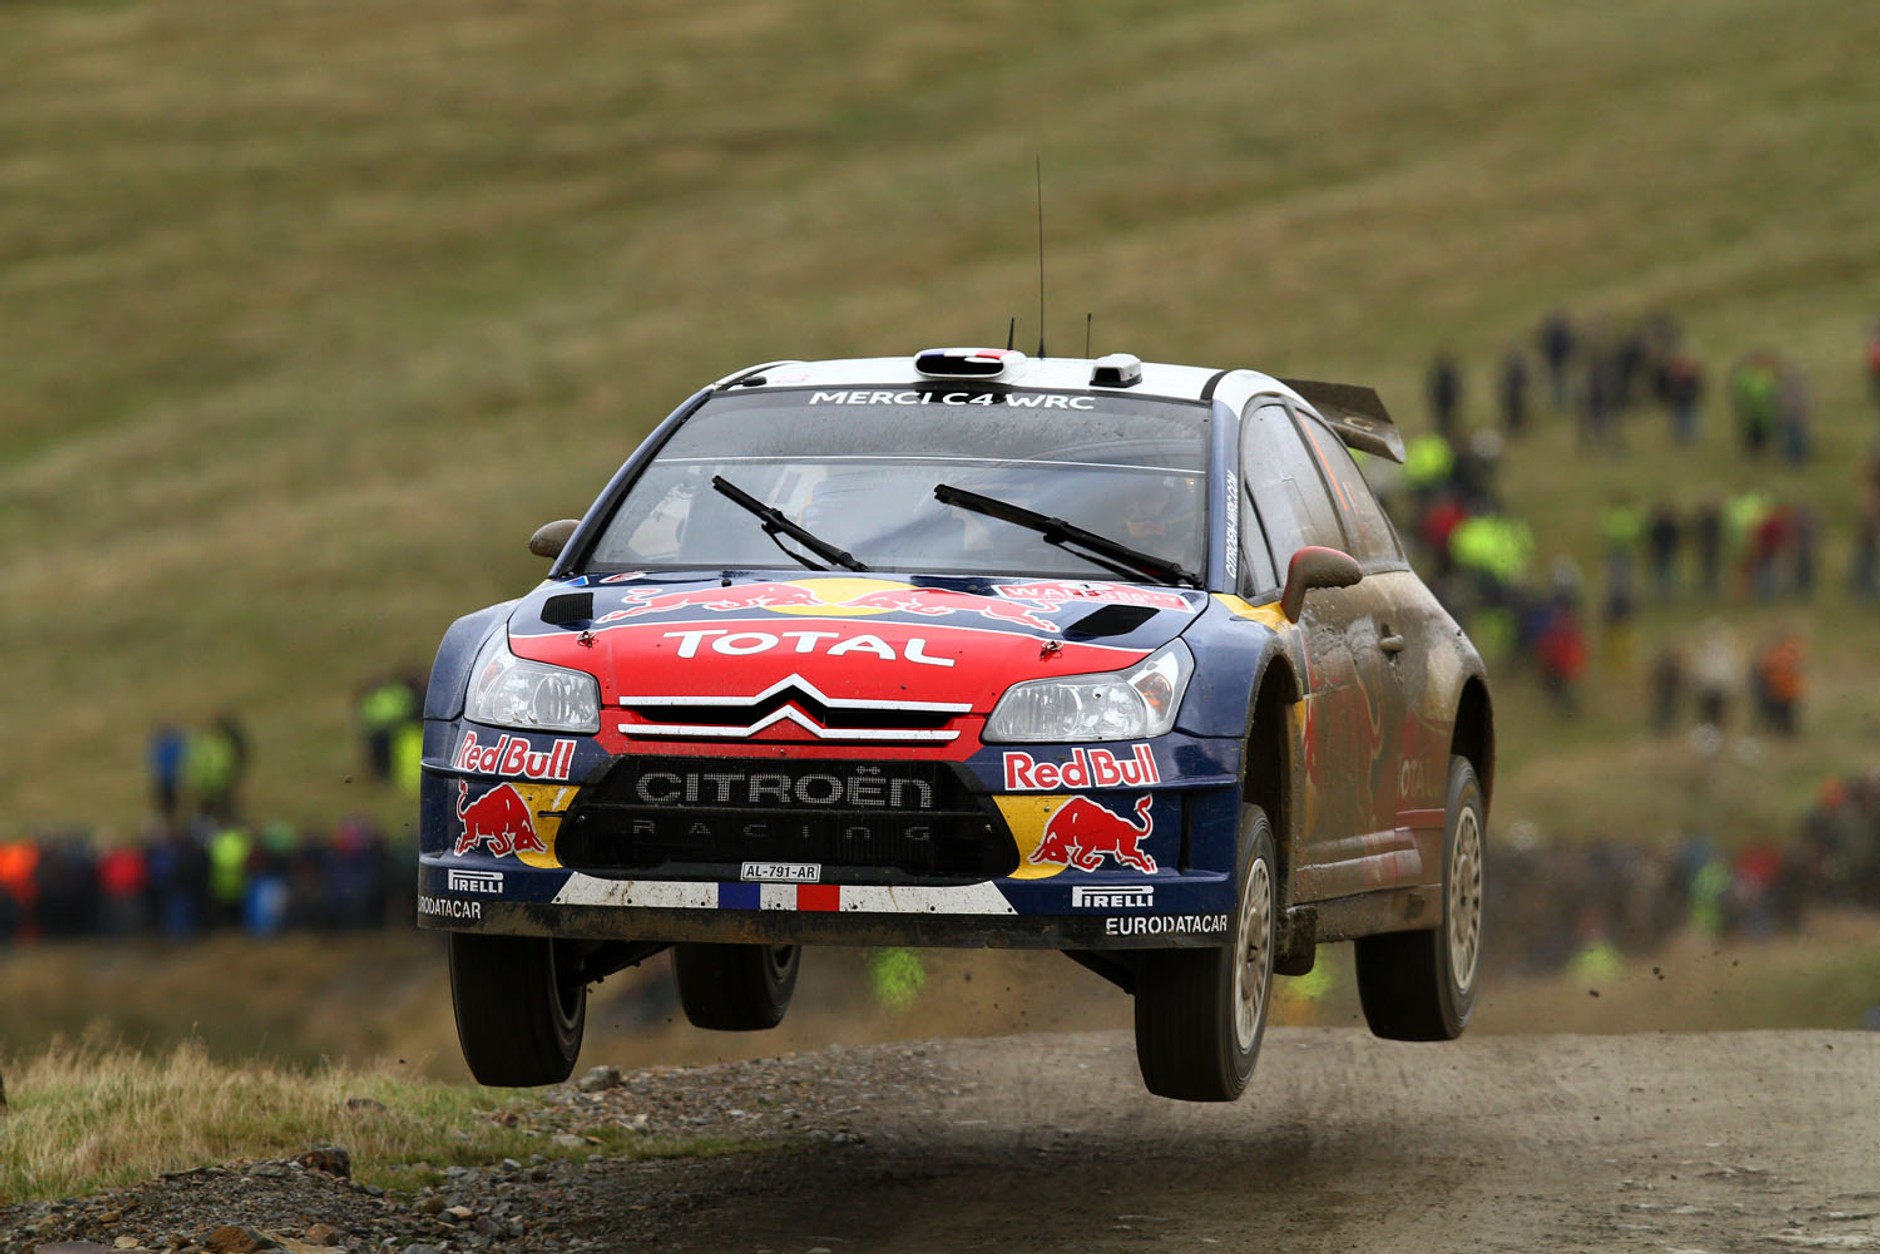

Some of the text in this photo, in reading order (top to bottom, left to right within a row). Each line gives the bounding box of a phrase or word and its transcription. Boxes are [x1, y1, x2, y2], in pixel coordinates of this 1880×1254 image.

[808, 391, 1097, 410] MERCI C4 WRC
[663, 629, 955, 668] TOTAL
[454, 730, 577, 780] Red Bull
[1003, 743, 1160, 790] Red Bull
[448, 869, 504, 893] PIRELLI
[745, 864, 815, 879] AL-791-AR
[1072, 886, 1154, 907] PIRELLI
[1106, 915, 1228, 935] EURODATACAR
